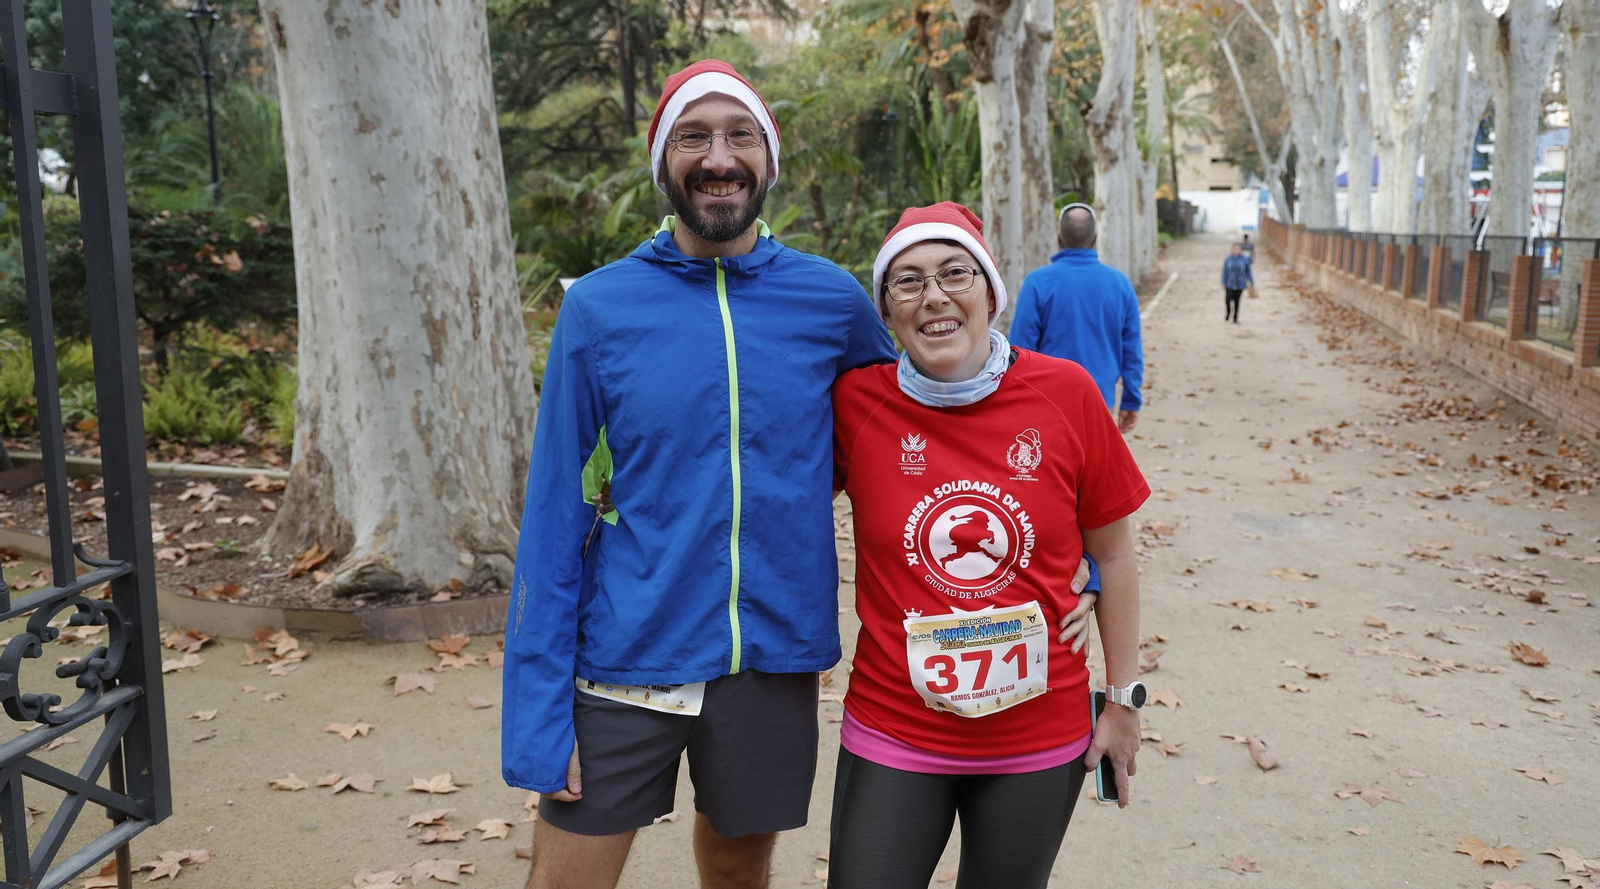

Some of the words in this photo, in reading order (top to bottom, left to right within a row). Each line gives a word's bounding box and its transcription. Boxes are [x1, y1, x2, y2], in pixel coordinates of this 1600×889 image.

[901, 452, 926, 463] UCA
[933, 479, 1001, 499] SOLIDARIA
[1001, 493, 1021, 512] DE
[903, 495, 935, 550] CARRERA
[1016, 510, 1036, 569] NAVIDAD
[906, 552, 920, 567] XI
[924, 574, 957, 598] CIUDAD
[958, 591, 972, 599] DE
[973, 571, 1017, 599] ALGECIRAS
[966, 616, 992, 626] EDICIÓN
[932, 625, 978, 644] CARRERA
[978, 619, 1023, 639] NAVIDAD
[990, 634, 1023, 645] ALGECIRAS
[923, 642, 1028, 695] 371
[950, 693, 971, 702] RAMOS
[999, 683, 1015, 694] ALICIA
